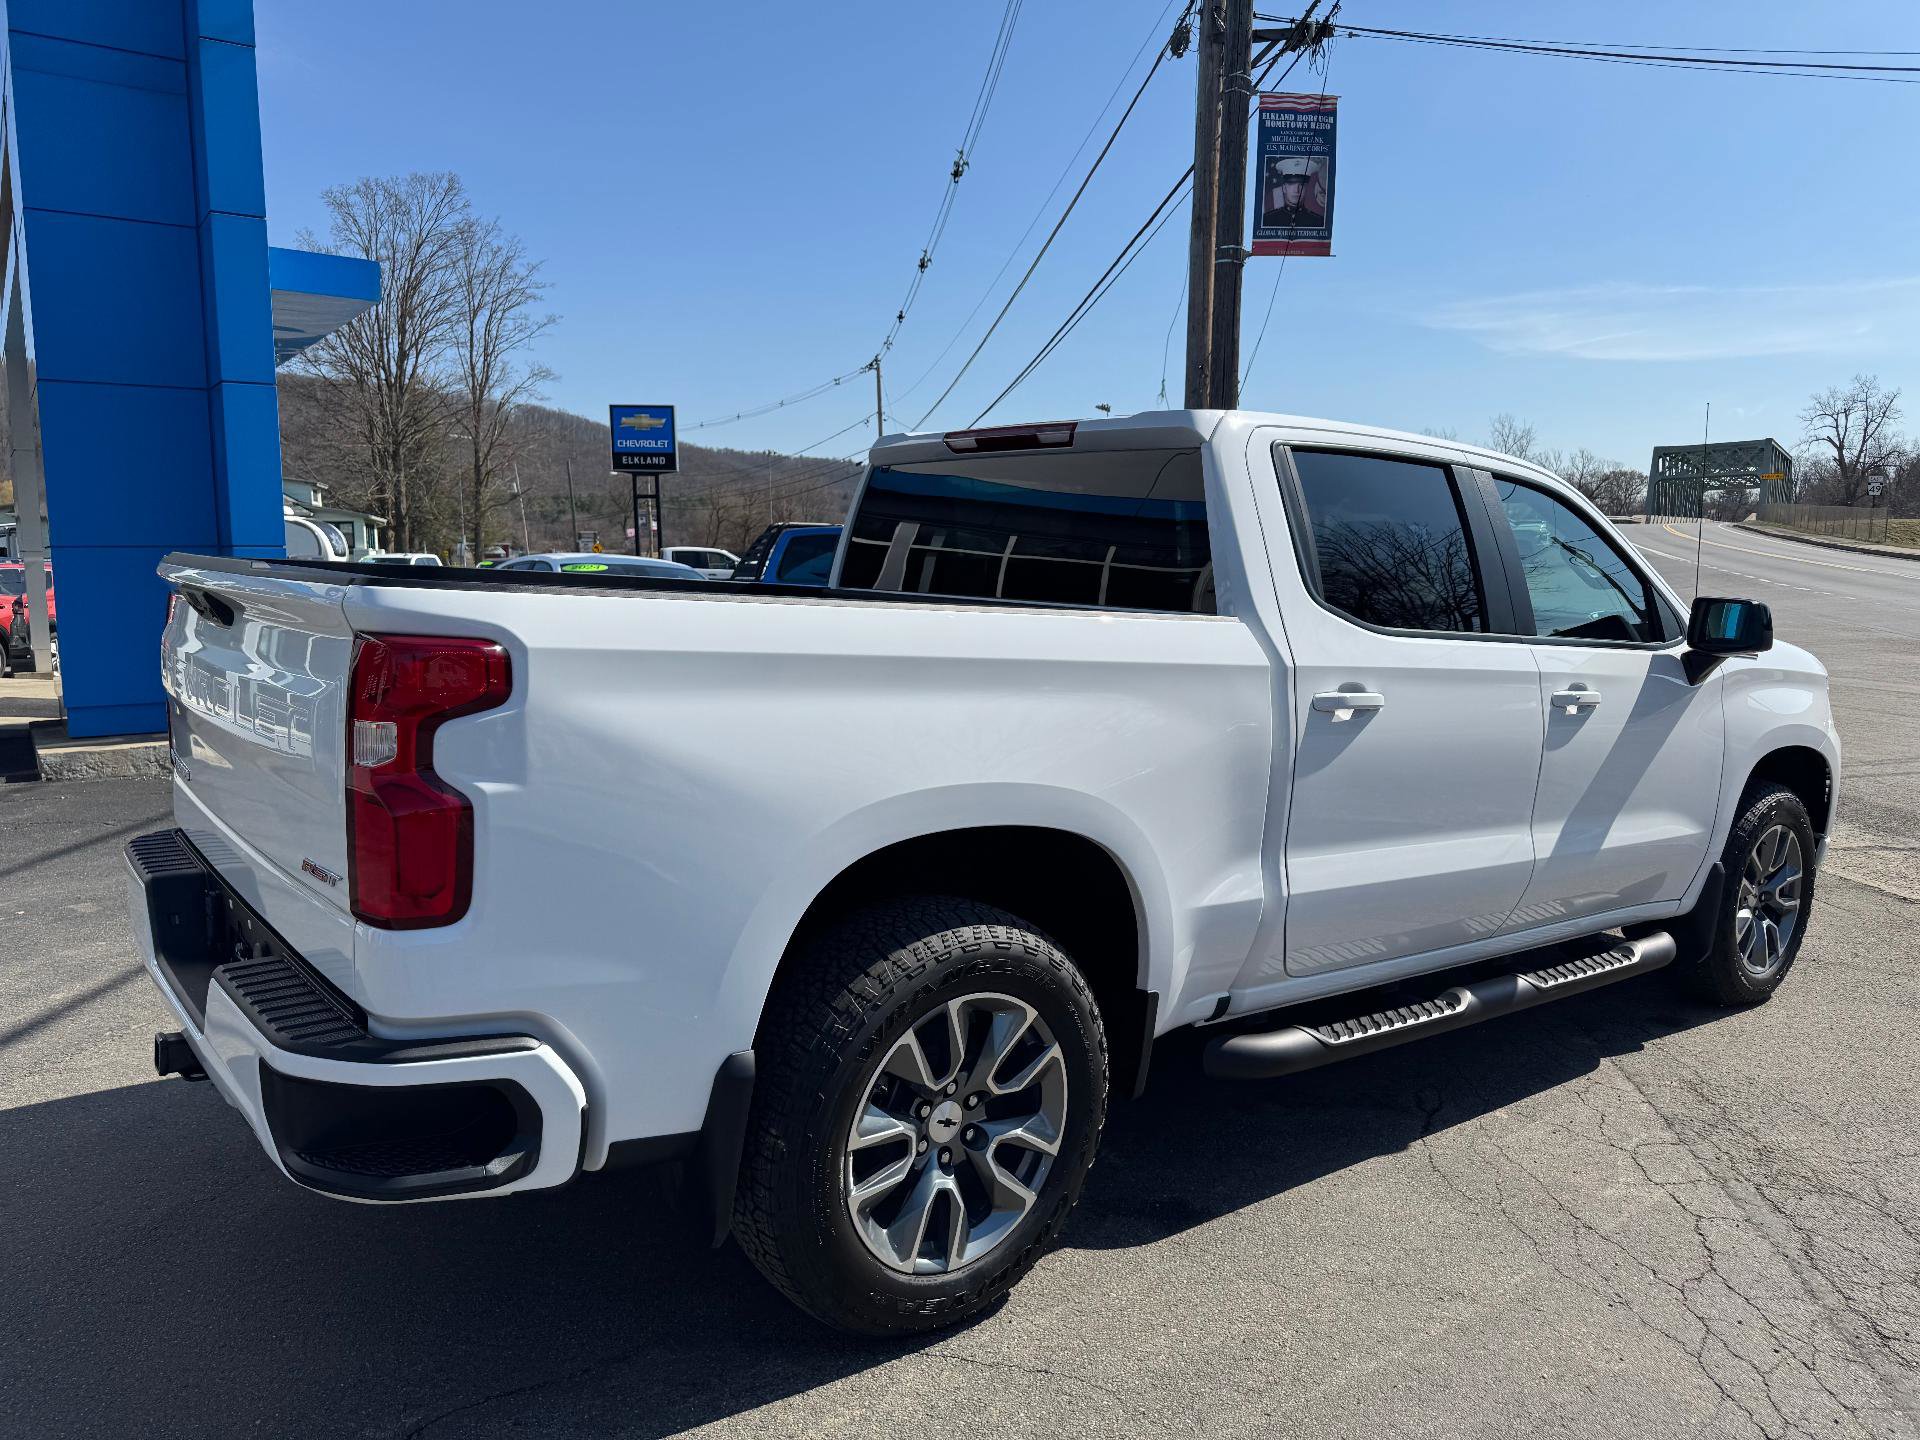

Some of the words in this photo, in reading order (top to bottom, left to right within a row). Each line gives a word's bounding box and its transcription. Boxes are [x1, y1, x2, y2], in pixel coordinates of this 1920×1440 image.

[1262, 112, 1295, 121] ELKLAND
[1297, 114, 1334, 123] BOROUGH
[1265, 120, 1308, 129] HOMETOWN
[1310, 122, 1331, 130] HERO
[617, 439, 669, 448] CHEVROLET
[622, 455, 666, 465] ELKLAND
[1869, 485, 1881, 493] 49
[301, 857, 343, 887] RST
